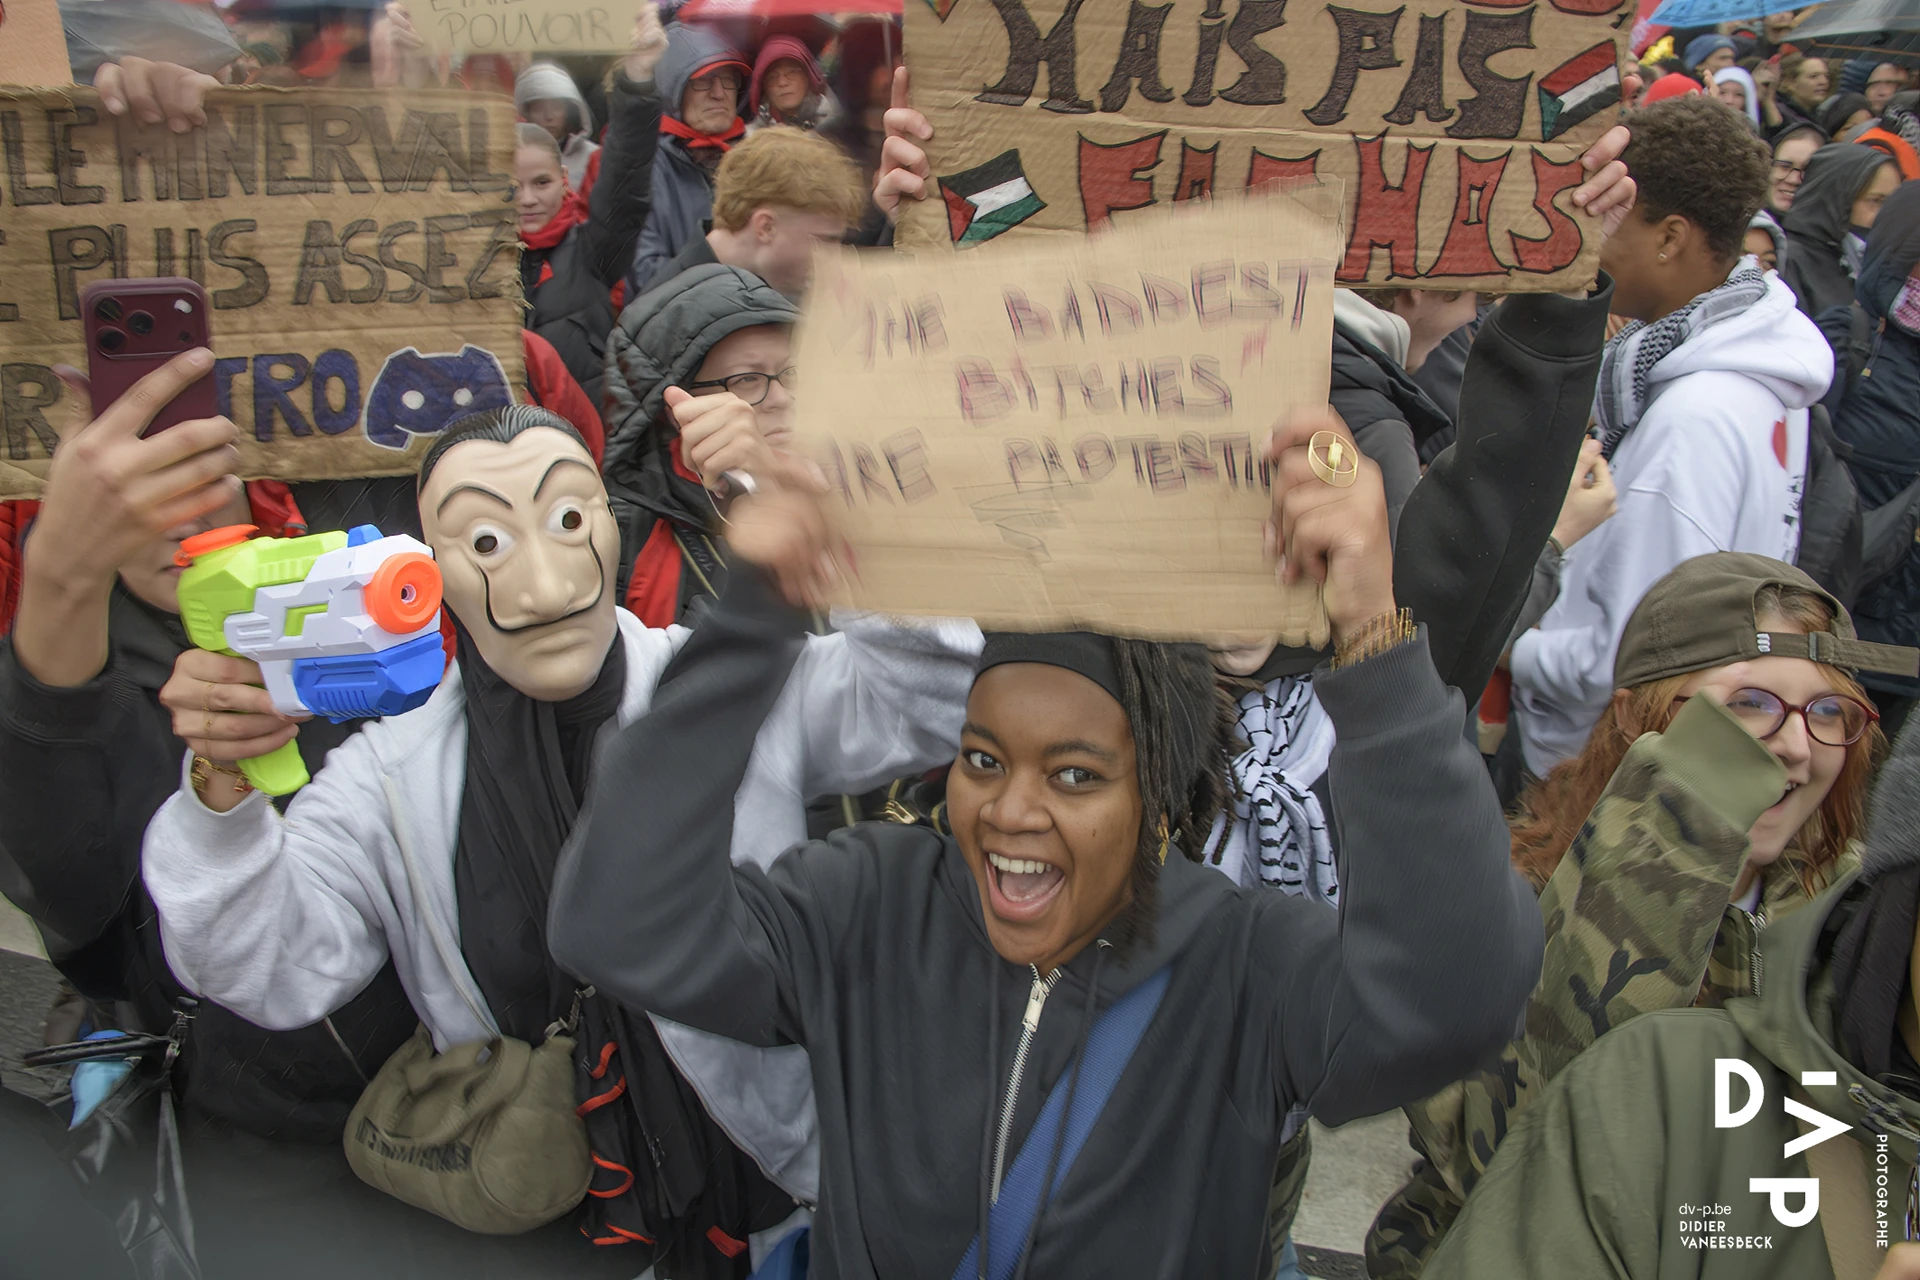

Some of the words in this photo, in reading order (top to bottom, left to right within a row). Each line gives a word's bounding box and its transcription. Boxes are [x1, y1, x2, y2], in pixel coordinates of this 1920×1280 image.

[438, 8, 615, 48] POUVOIR
[1302, 3, 1537, 139] PAS
[1, 106, 105, 206] LE
[293, 208, 519, 305] ASSEZ
